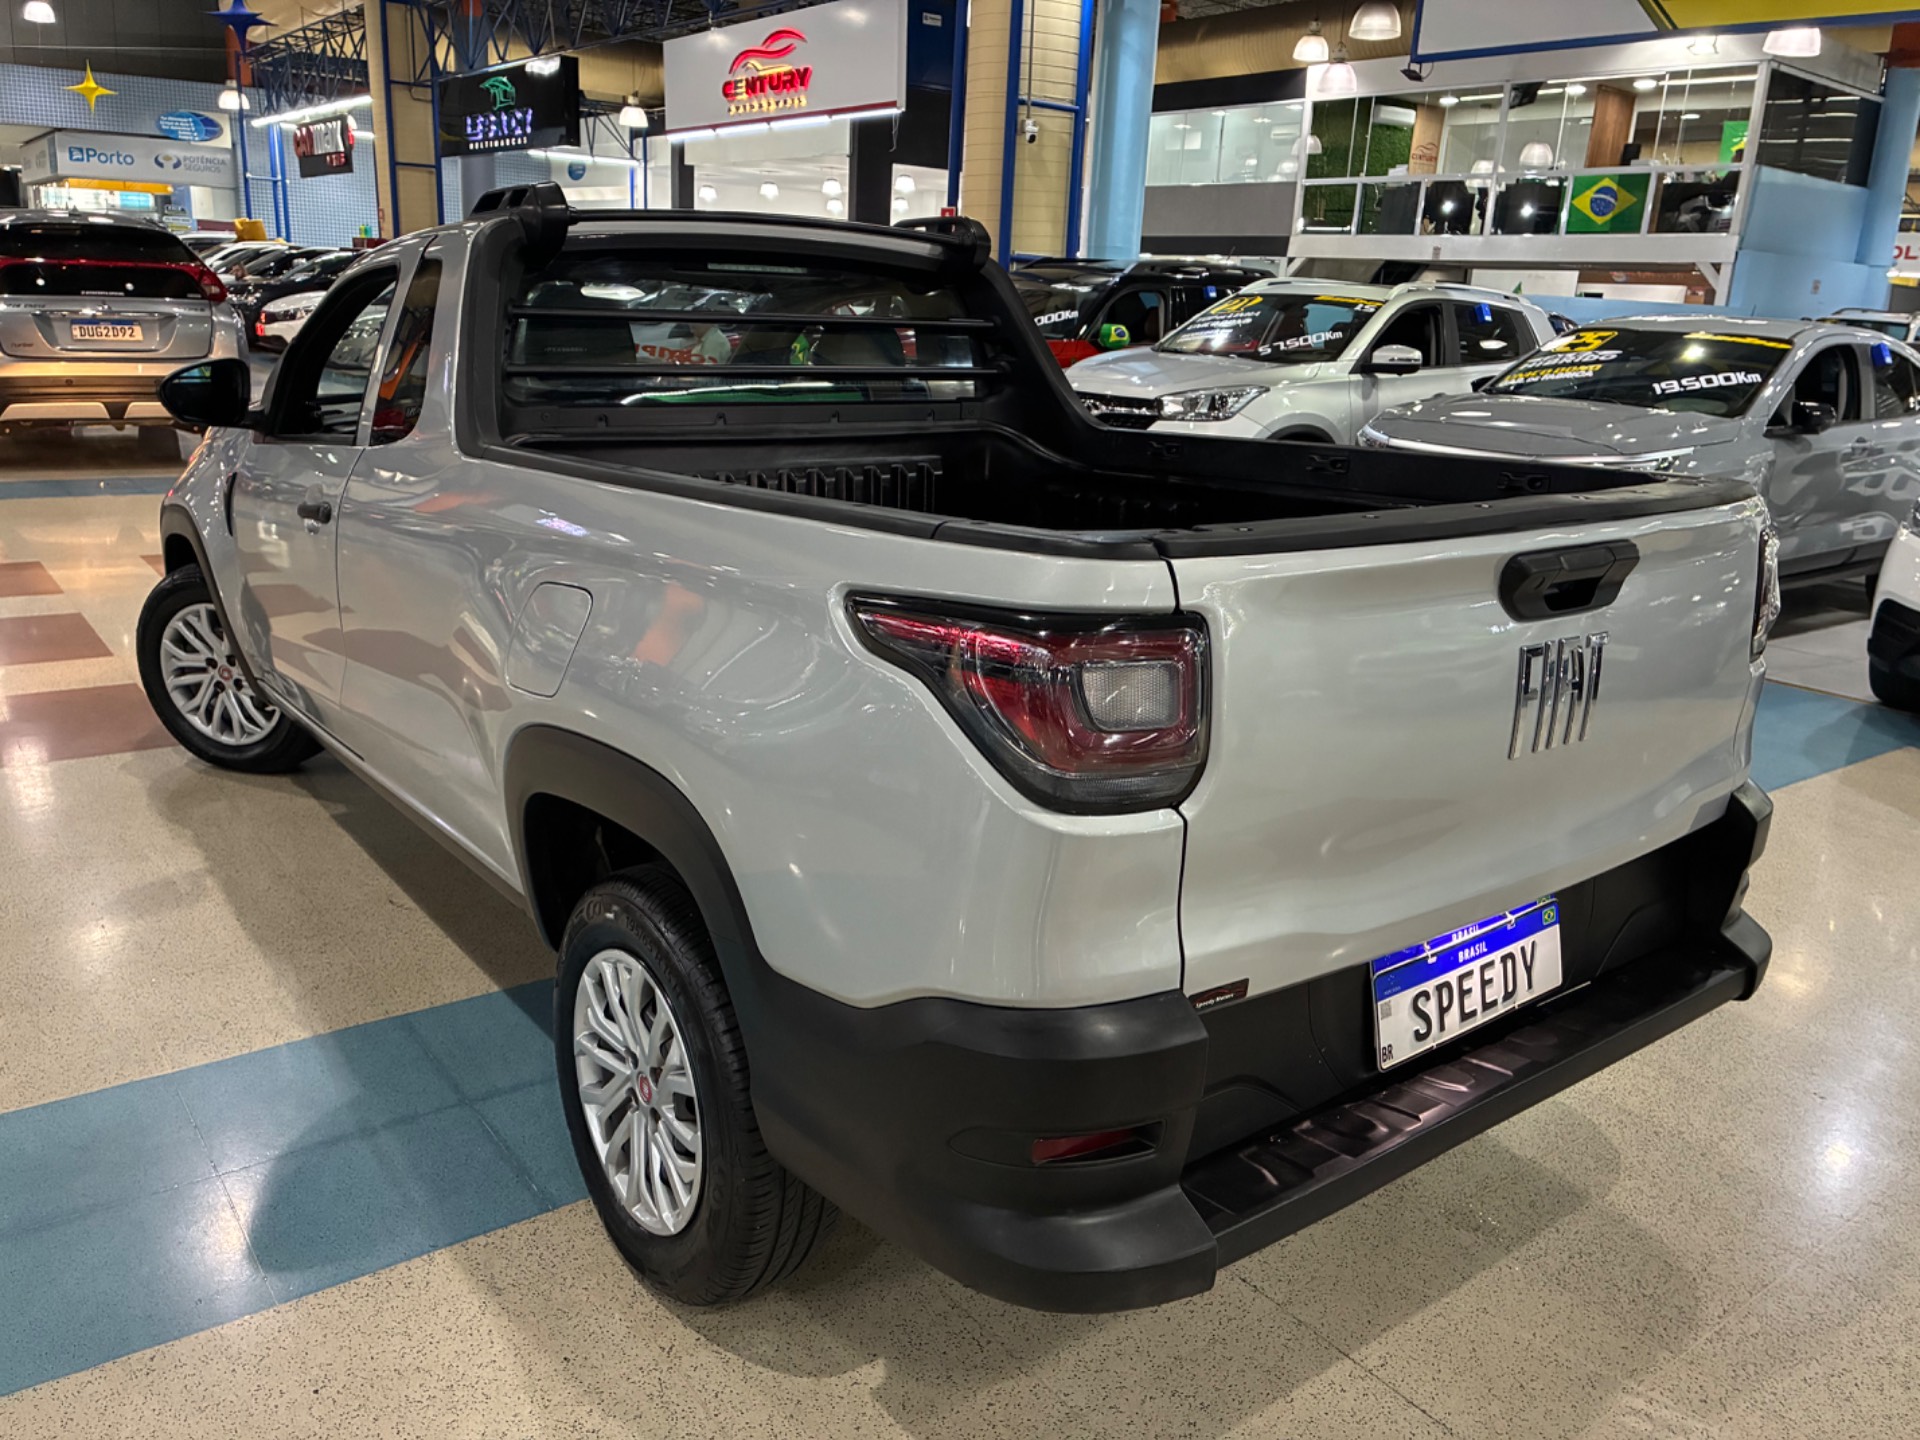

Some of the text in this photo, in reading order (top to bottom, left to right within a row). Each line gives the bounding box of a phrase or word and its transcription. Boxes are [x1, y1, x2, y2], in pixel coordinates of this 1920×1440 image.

[722, 65, 812, 102] CENTURY
[468, 136, 528, 150] MULTIMARCAS
[86, 148, 135, 166] Porto
[183, 153, 228, 166] POTÊNCIA
[184, 163, 222, 173] SEGUROS
[79, 326, 136, 338] DUG2D92
[1652, 371, 1763, 396] 19.500Km
[1507, 630, 1609, 761] FIAT
[1458, 941, 1489, 963] BRASIL
[1411, 940, 1537, 1043] SPEEDY
[1381, 1044, 1394, 1063] BR
